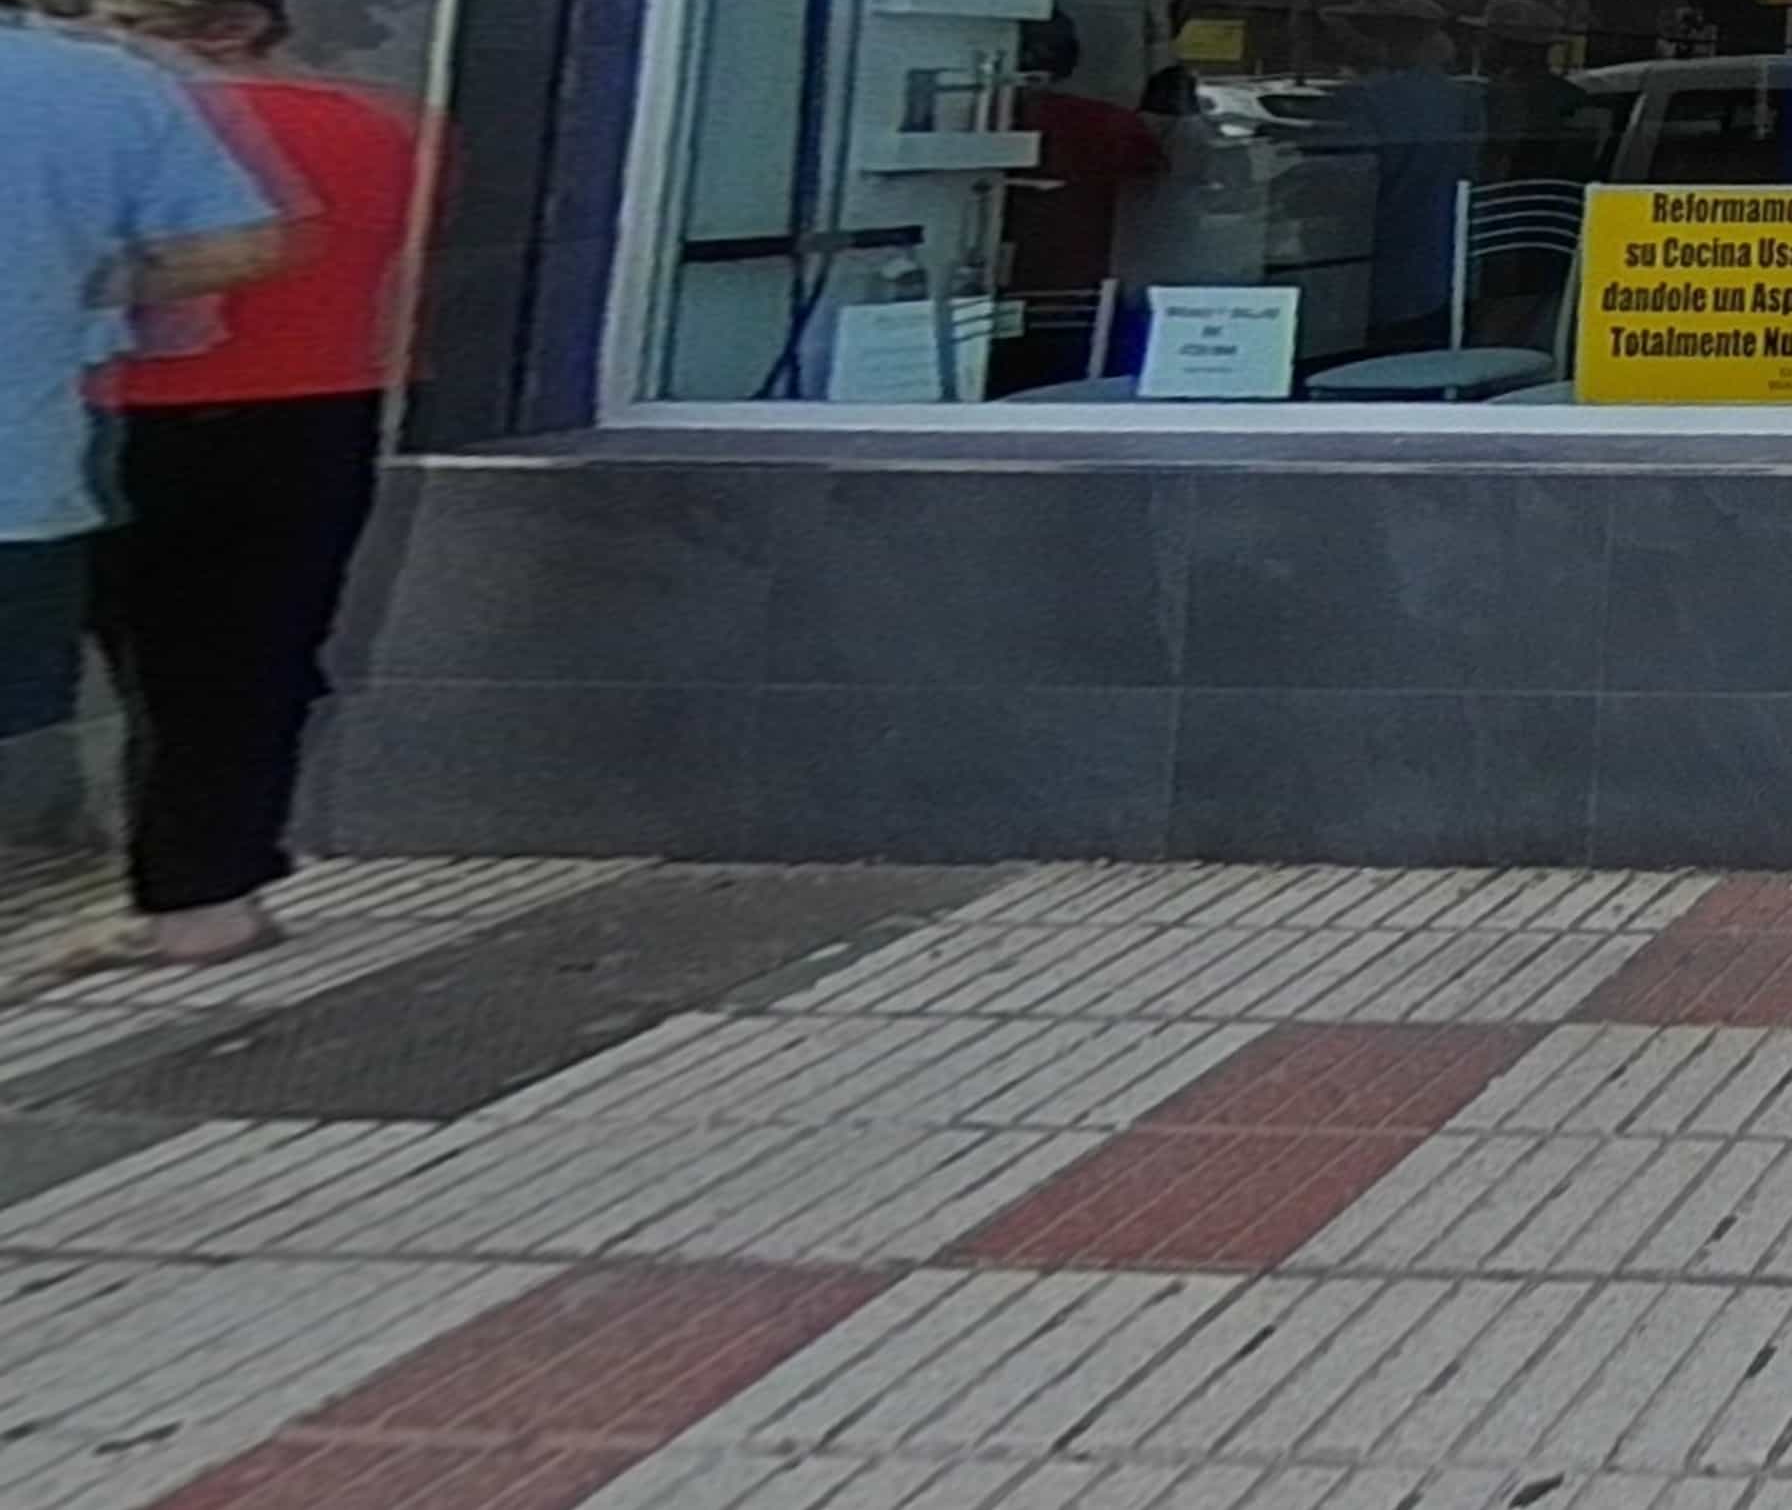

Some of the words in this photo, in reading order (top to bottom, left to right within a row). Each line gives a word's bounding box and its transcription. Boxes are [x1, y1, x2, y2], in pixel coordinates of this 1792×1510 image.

[1625, 242, 1656, 268] su
[1662, 237, 1752, 268] Cocina
[1602, 282, 1706, 312] dandole
[1712, 287, 1745, 312] un
[1609, 326, 1757, 358] Totalmente
